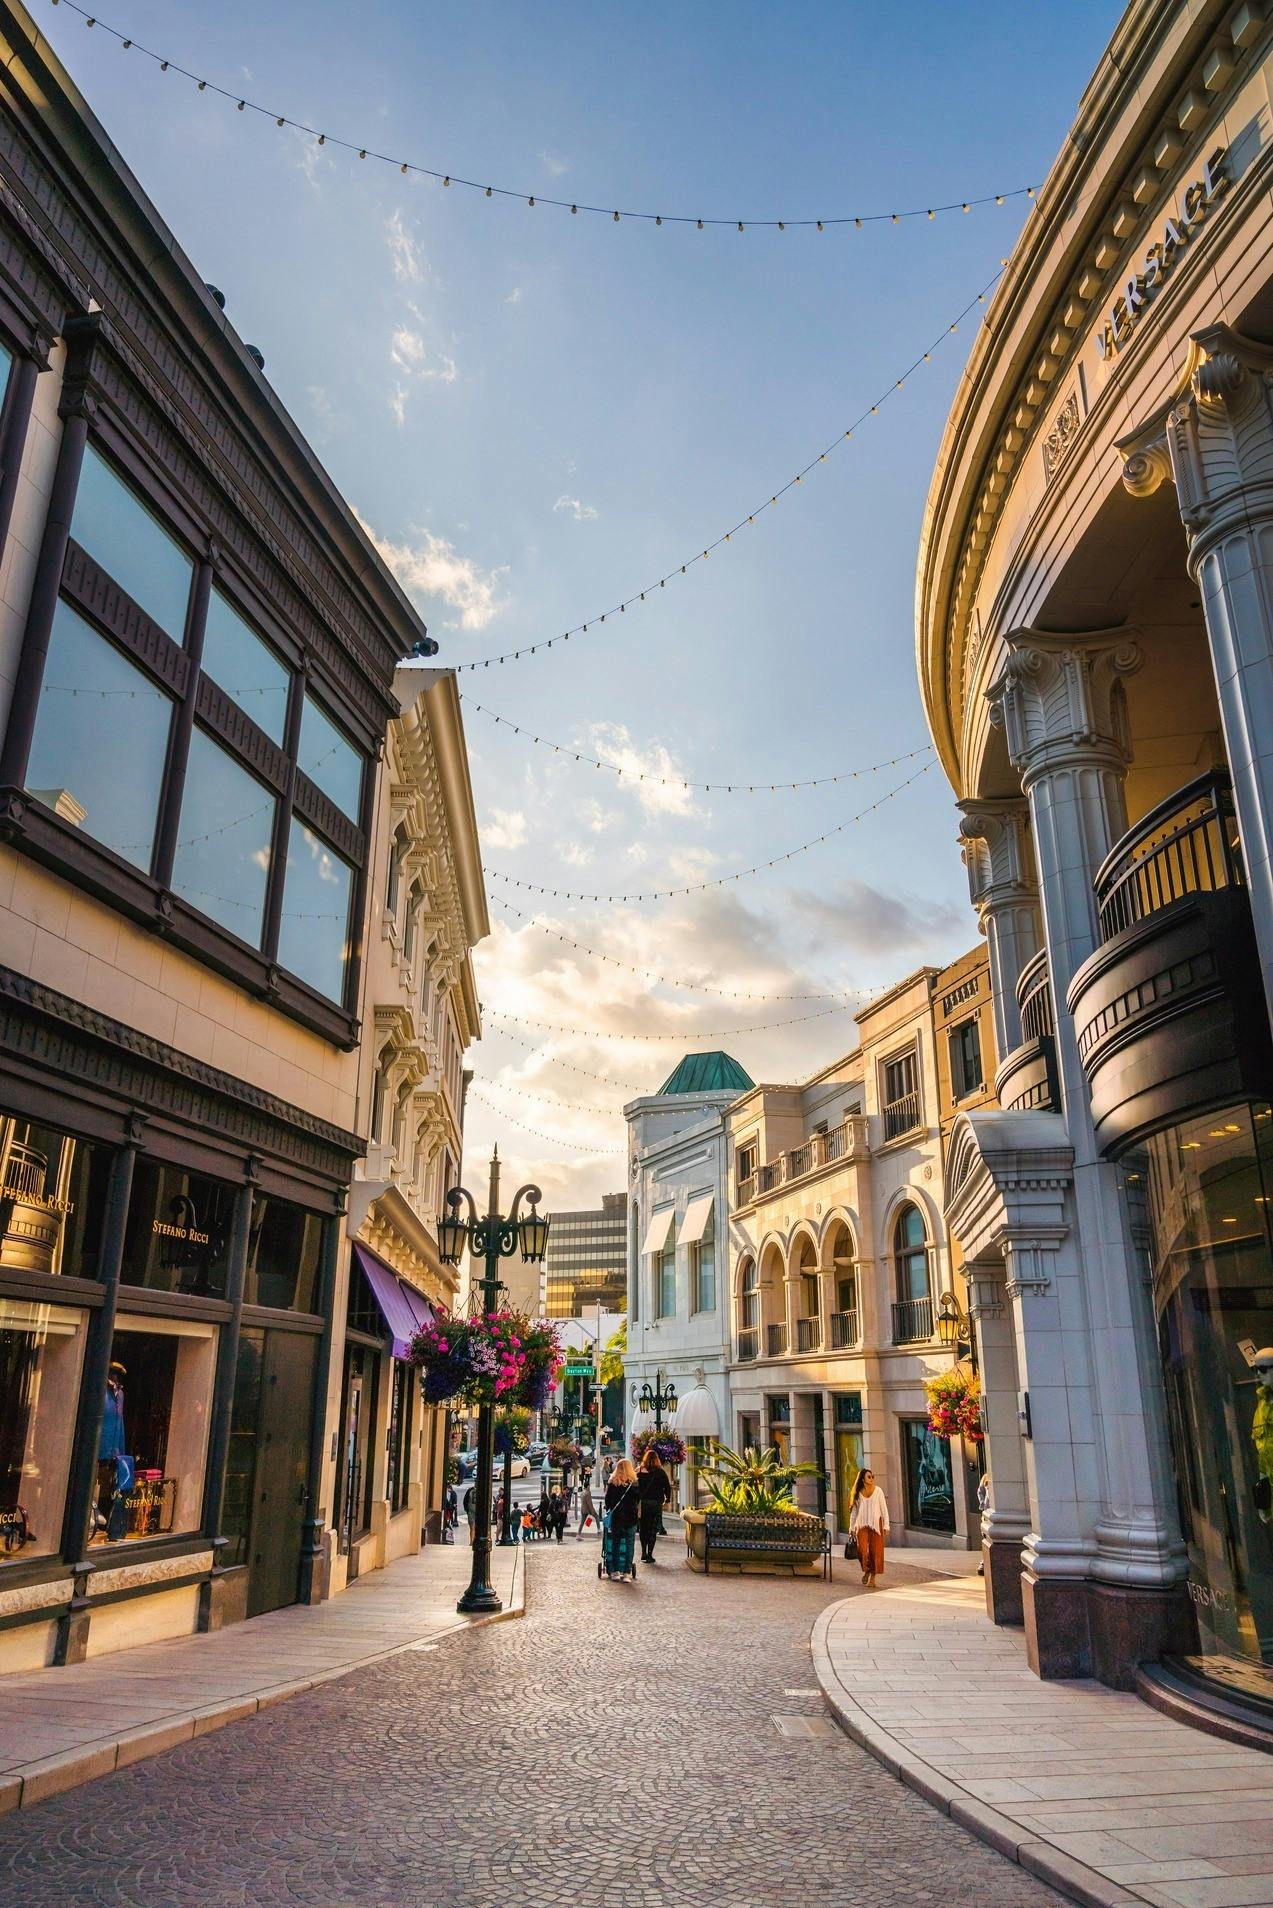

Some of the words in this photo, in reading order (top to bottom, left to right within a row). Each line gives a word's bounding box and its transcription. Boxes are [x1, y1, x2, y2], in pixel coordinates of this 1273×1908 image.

[1095, 147, 1229, 361] VERSACE
[47, 1194, 75, 1214] RICCI
[152, 1220, 187, 1239] STEFANO
[189, 1228, 209, 1244] RICCI
